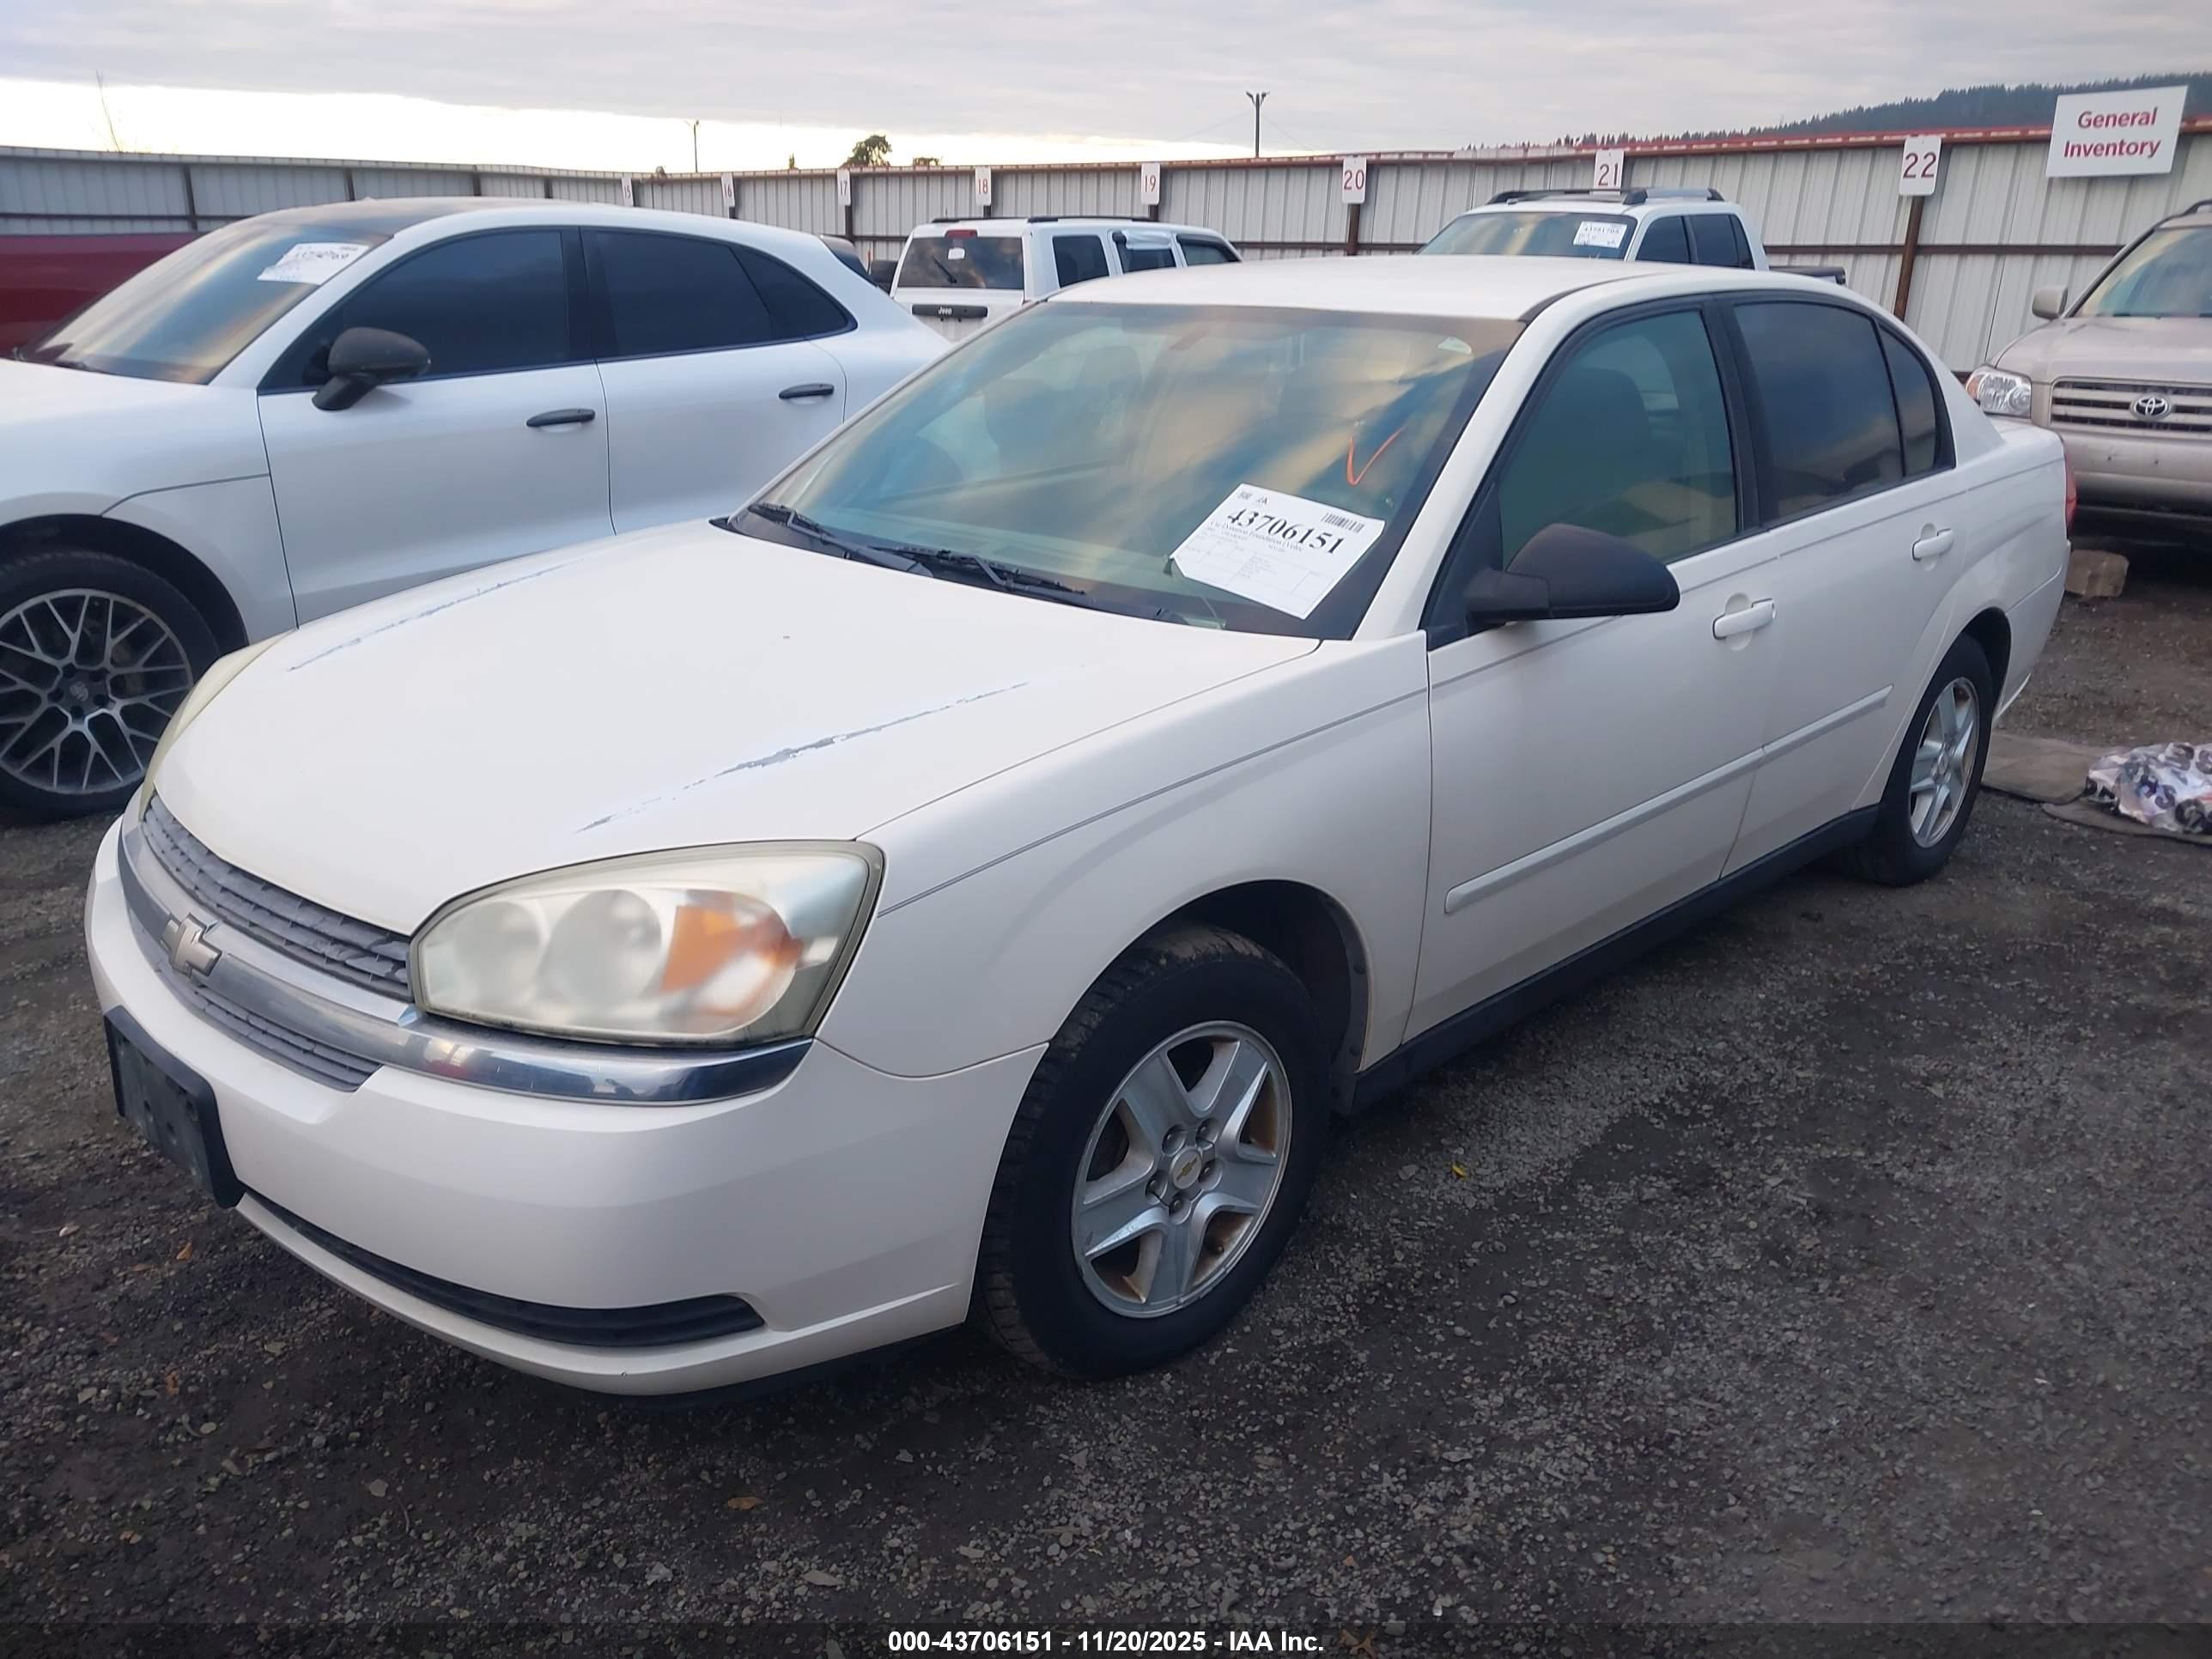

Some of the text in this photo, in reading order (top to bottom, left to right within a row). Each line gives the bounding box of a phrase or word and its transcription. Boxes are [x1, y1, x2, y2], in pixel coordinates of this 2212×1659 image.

[2077, 106, 2158, 130] General
[2063, 138, 2161, 159] Inventory
[1598, 163, 1619, 186] 21
[1903, 152, 1937, 179] 22
[840, 179, 848, 196] 17
[978, 178, 988, 195] 18
[1145, 174, 1157, 192] 19
[1344, 169, 1364, 190] 20
[1227, 507, 1346, 555] 43706151
